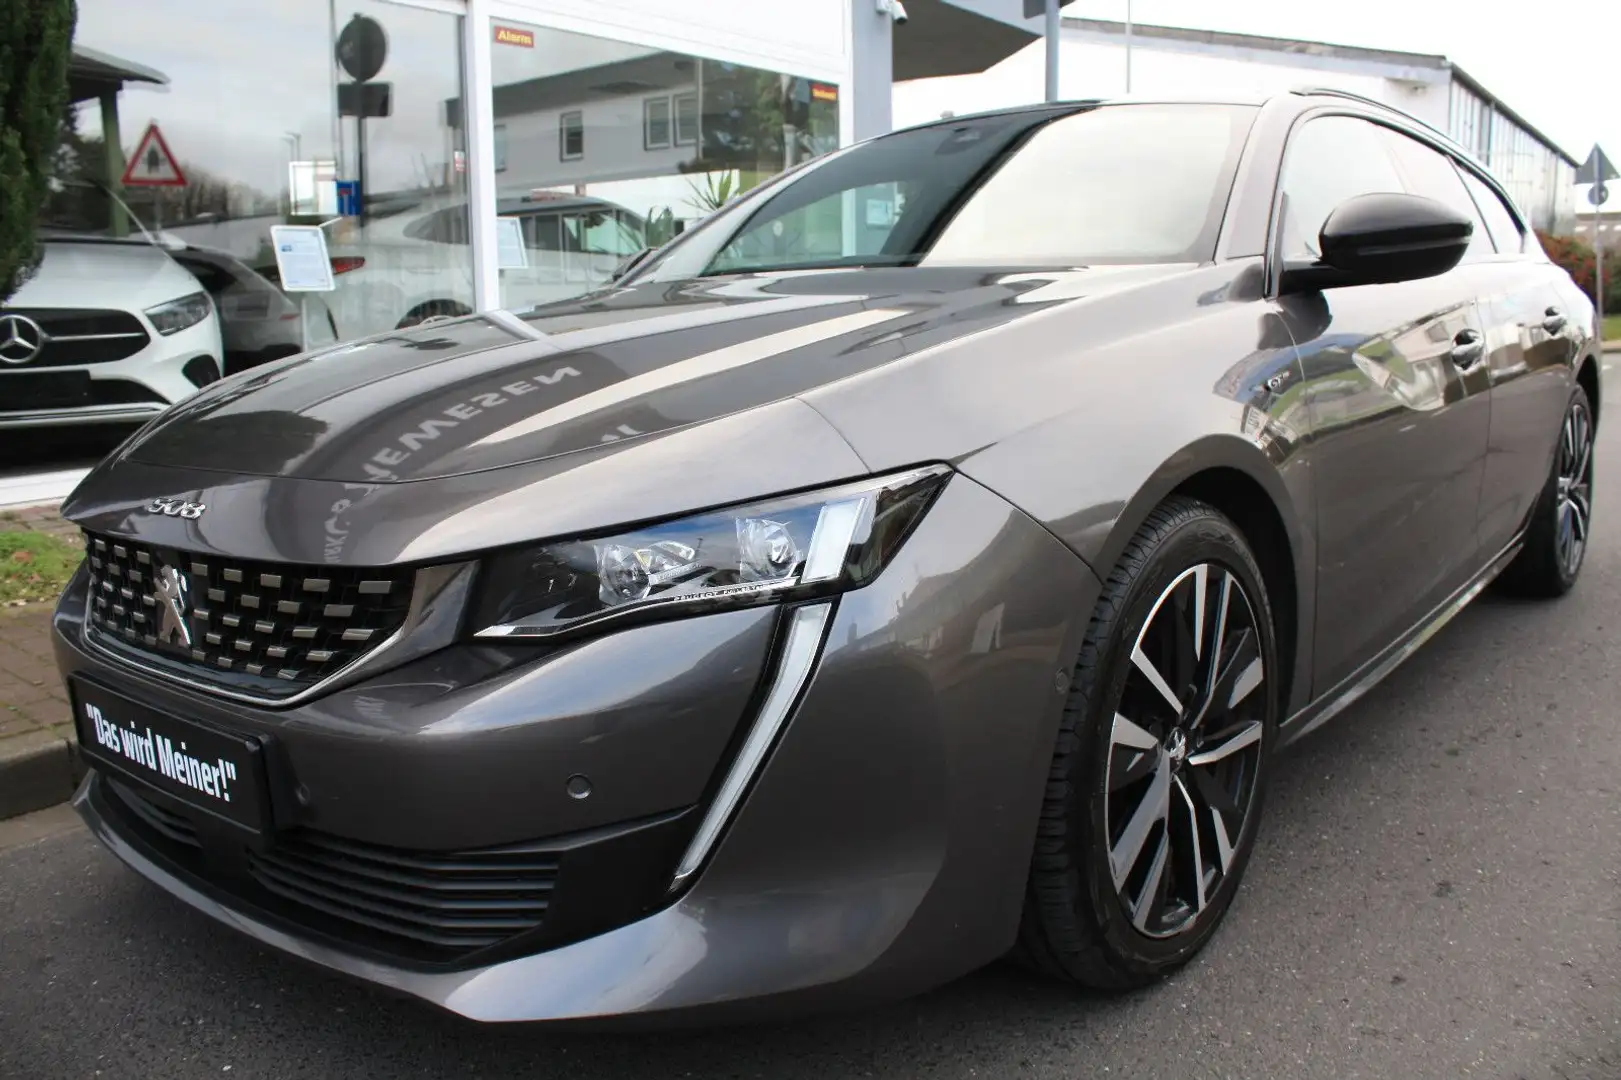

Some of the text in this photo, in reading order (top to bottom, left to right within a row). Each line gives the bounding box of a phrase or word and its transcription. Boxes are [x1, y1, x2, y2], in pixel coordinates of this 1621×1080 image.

[497, 29, 532, 44] Alarm
[147, 498, 206, 520] 508
[85, 702, 236, 802] "Das wird Meiner!"
